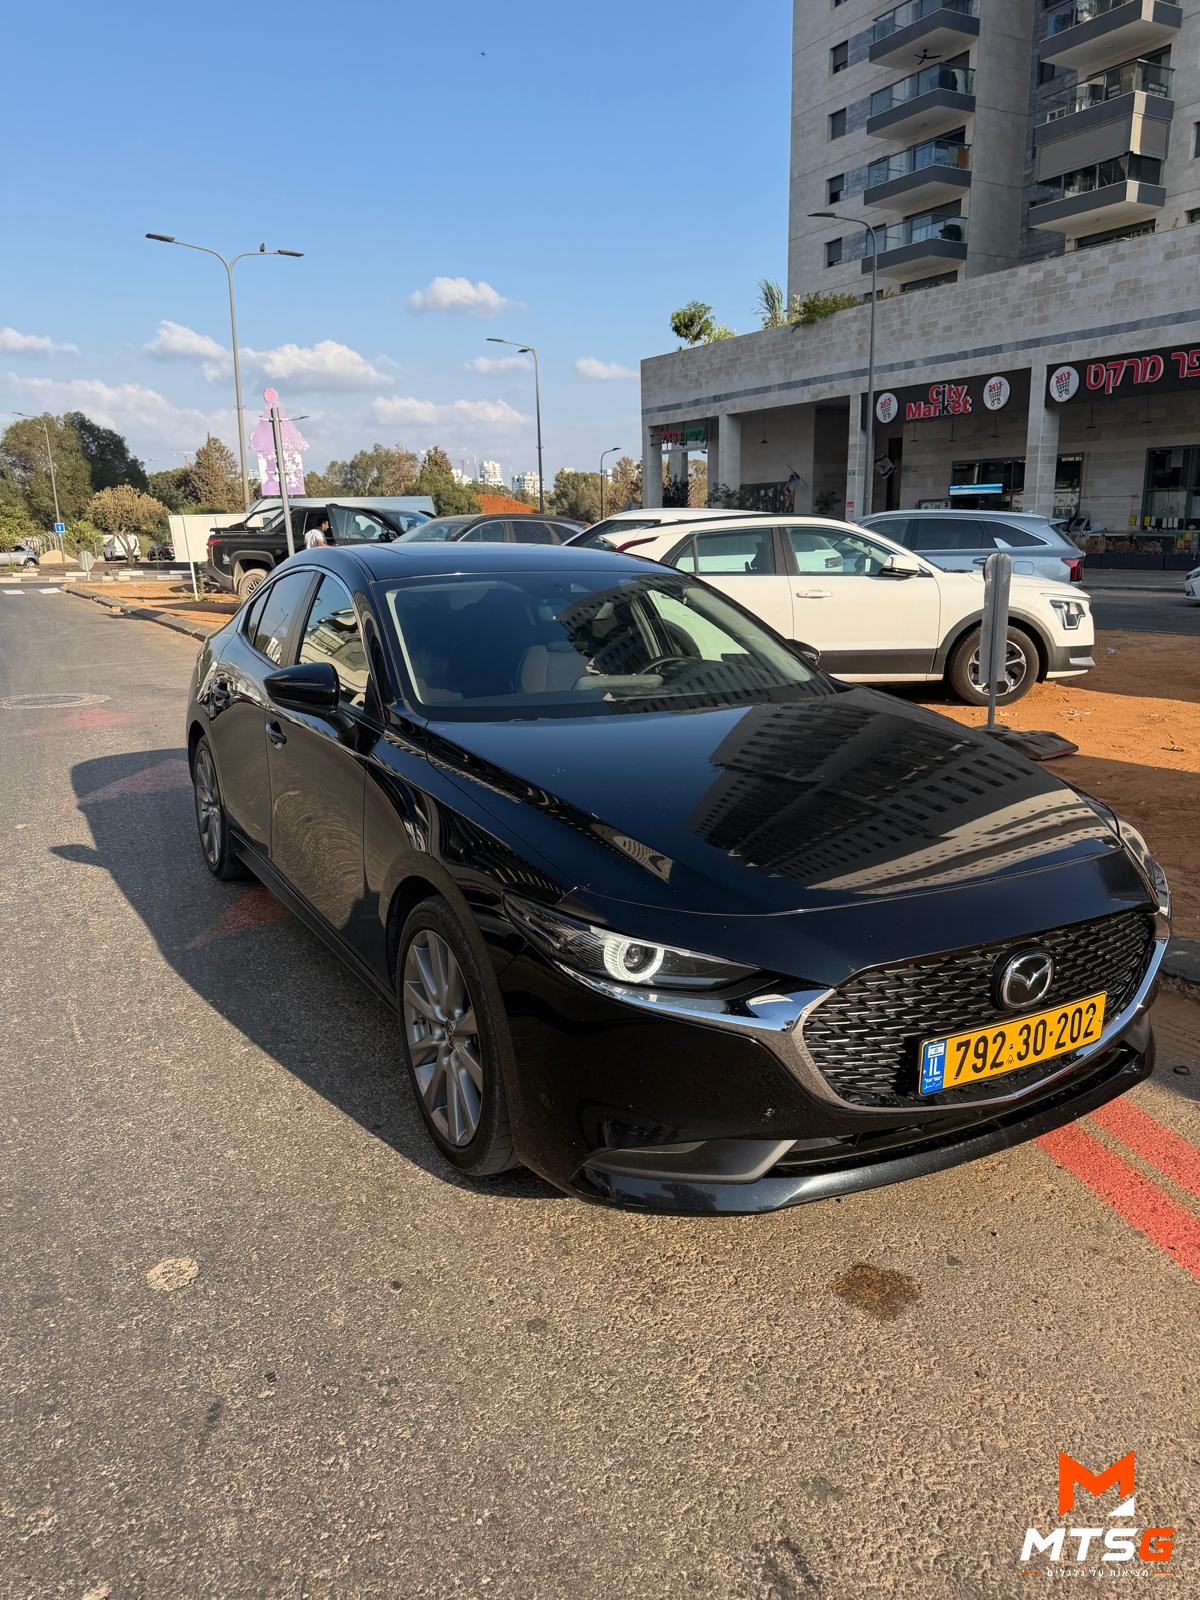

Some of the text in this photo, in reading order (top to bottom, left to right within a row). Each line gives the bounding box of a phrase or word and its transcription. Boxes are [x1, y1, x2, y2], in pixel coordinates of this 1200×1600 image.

[1086, 355, 1164, 394] מרקט
[929, 383, 968, 403] City
[906, 395, 972, 420] Market
[929, 1057, 941, 1077] IL
